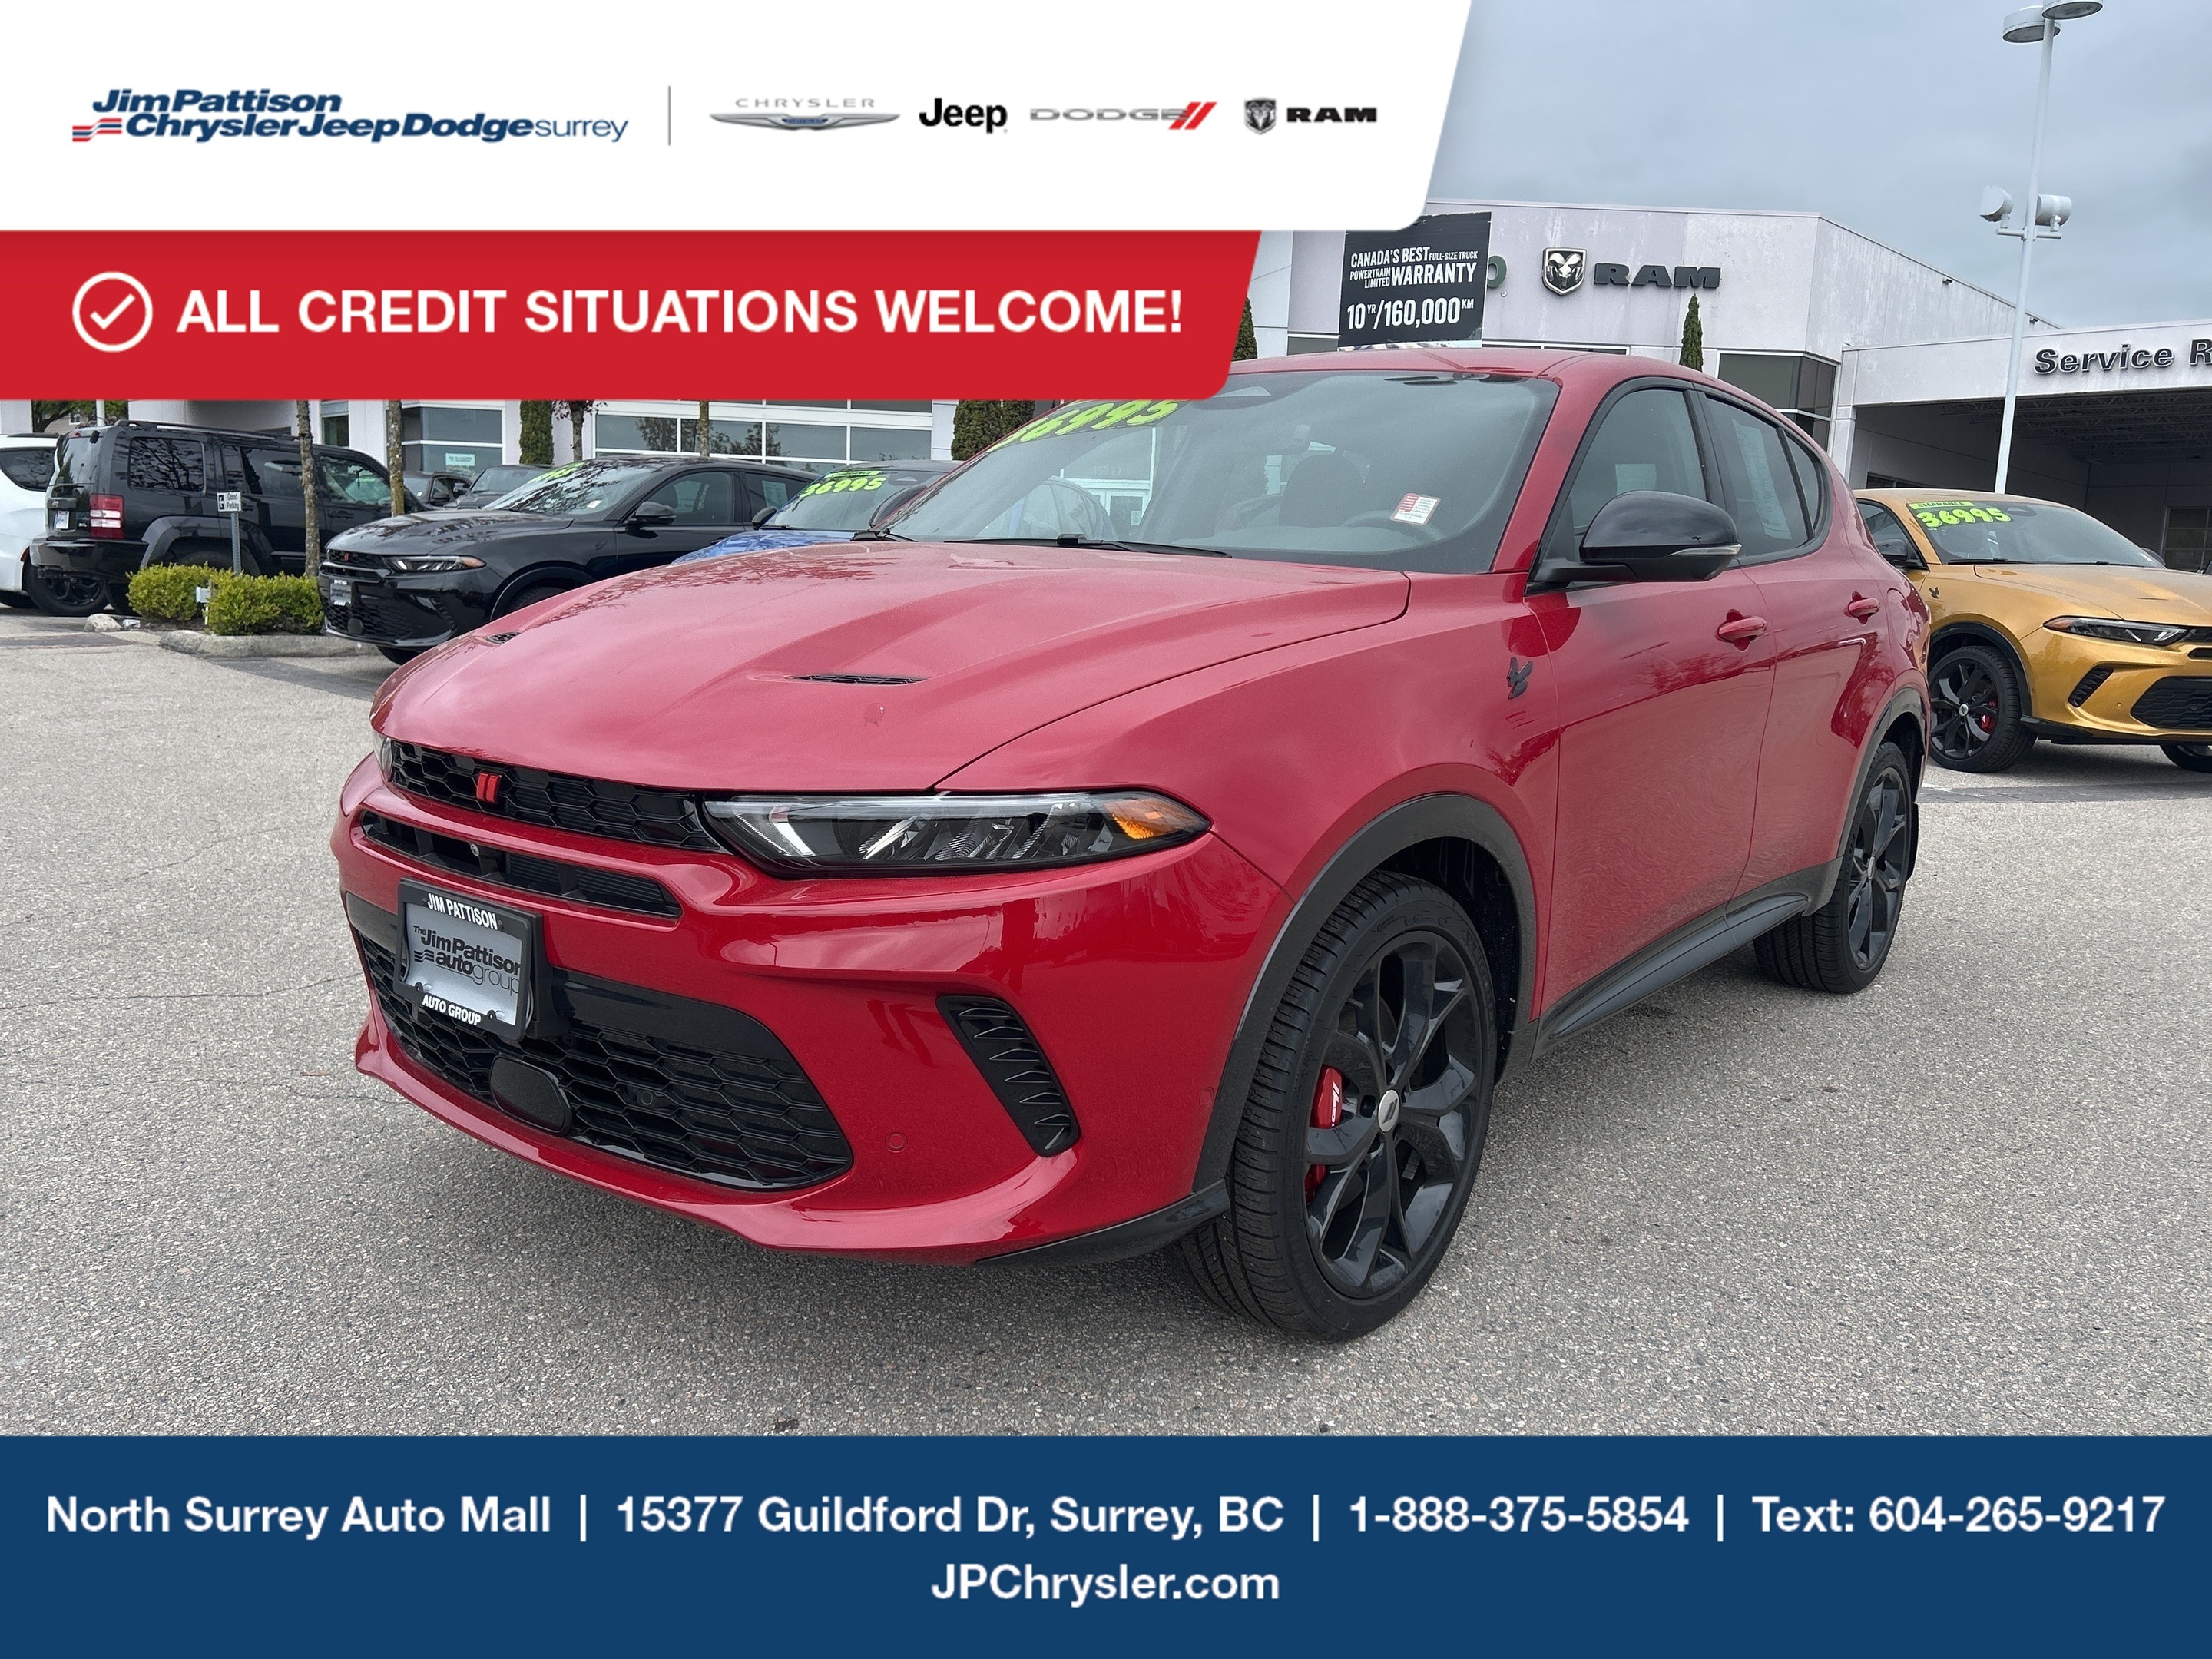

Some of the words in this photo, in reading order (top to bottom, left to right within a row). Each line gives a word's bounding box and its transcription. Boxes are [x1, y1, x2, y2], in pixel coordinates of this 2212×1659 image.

[1350, 249, 1399, 268] CANADA'S
[1402, 247, 1430, 263] BEST
[1429, 253, 1458, 261] FULL-SIZE
[1459, 251, 1479, 260] TRUCK
[1349, 267, 1391, 281] POWERTRAIN
[1364, 277, 1390, 289] LIMITED
[1392, 262, 1478, 286] WARRANTY
[1594, 263, 1721, 289] RAM
[2035, 343, 2175, 375] Service
[799, 477, 887, 498] 36995
[1916, 508, 2012, 528] 36995
[427, 892, 445, 914] JIM
[445, 899, 498, 930] PATTISON
[413, 925, 426, 935] The
[422, 994, 446, 1013] AUTO
[448, 1004, 482, 1026] GROUP
